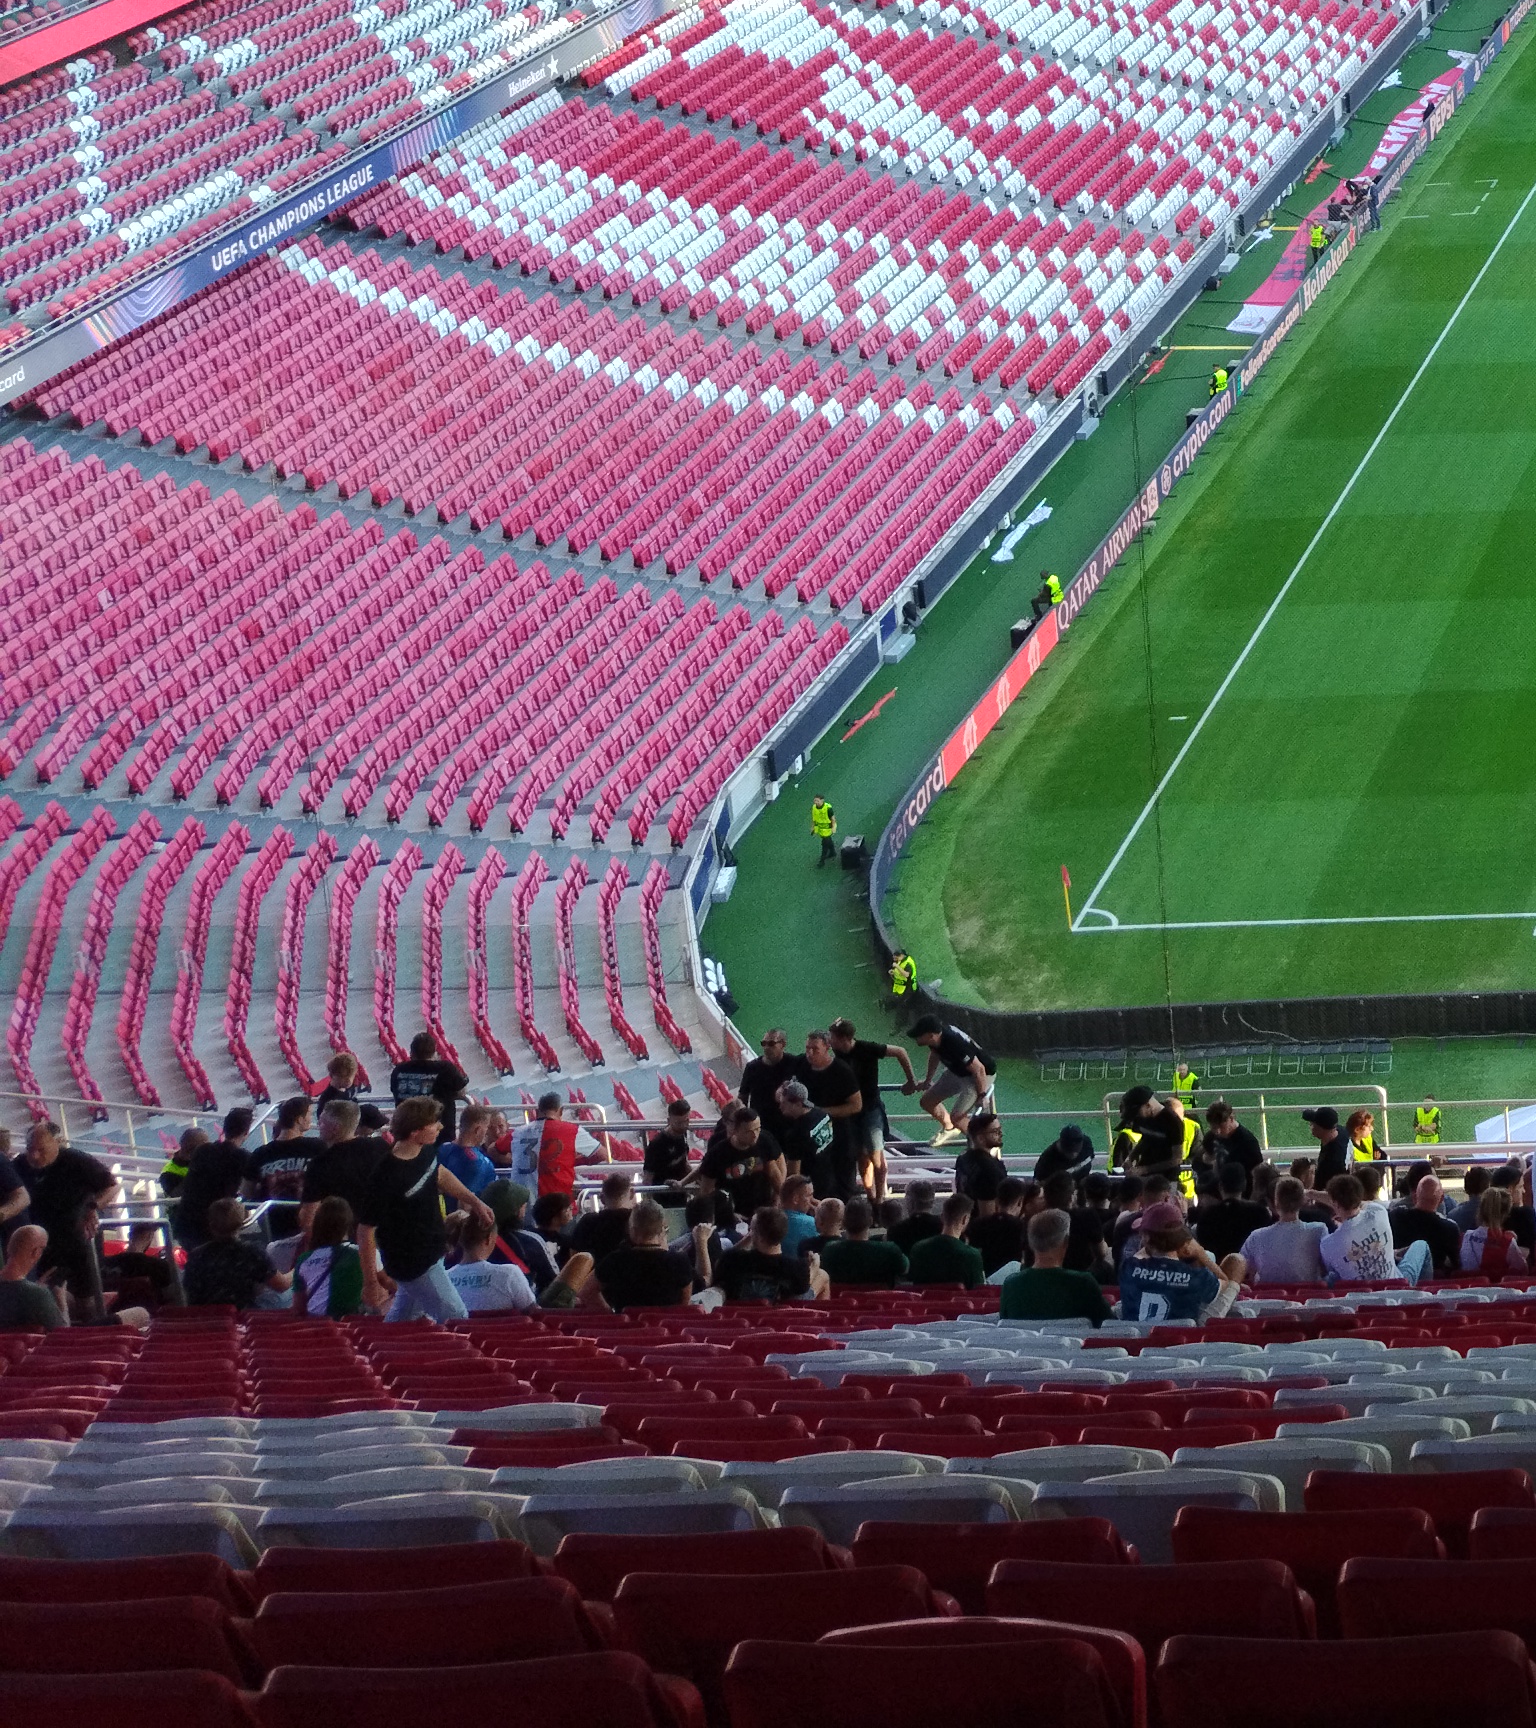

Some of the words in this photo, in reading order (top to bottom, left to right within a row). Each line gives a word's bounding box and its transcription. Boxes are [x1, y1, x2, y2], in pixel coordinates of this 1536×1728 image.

[1429, 88, 1455, 142] PEPSI
[211, 239, 249, 272] UEFA
[248, 195, 327, 249] CHAMPIONS
[327, 163, 375, 207] LEAGUE
[1302, 238, 1350, 312] Heineken
[1172, 389, 1232, 478] crypto.com
[1057, 560, 1100, 631] QATAR
[1102, 494, 1149, 575] AIRWAYS
